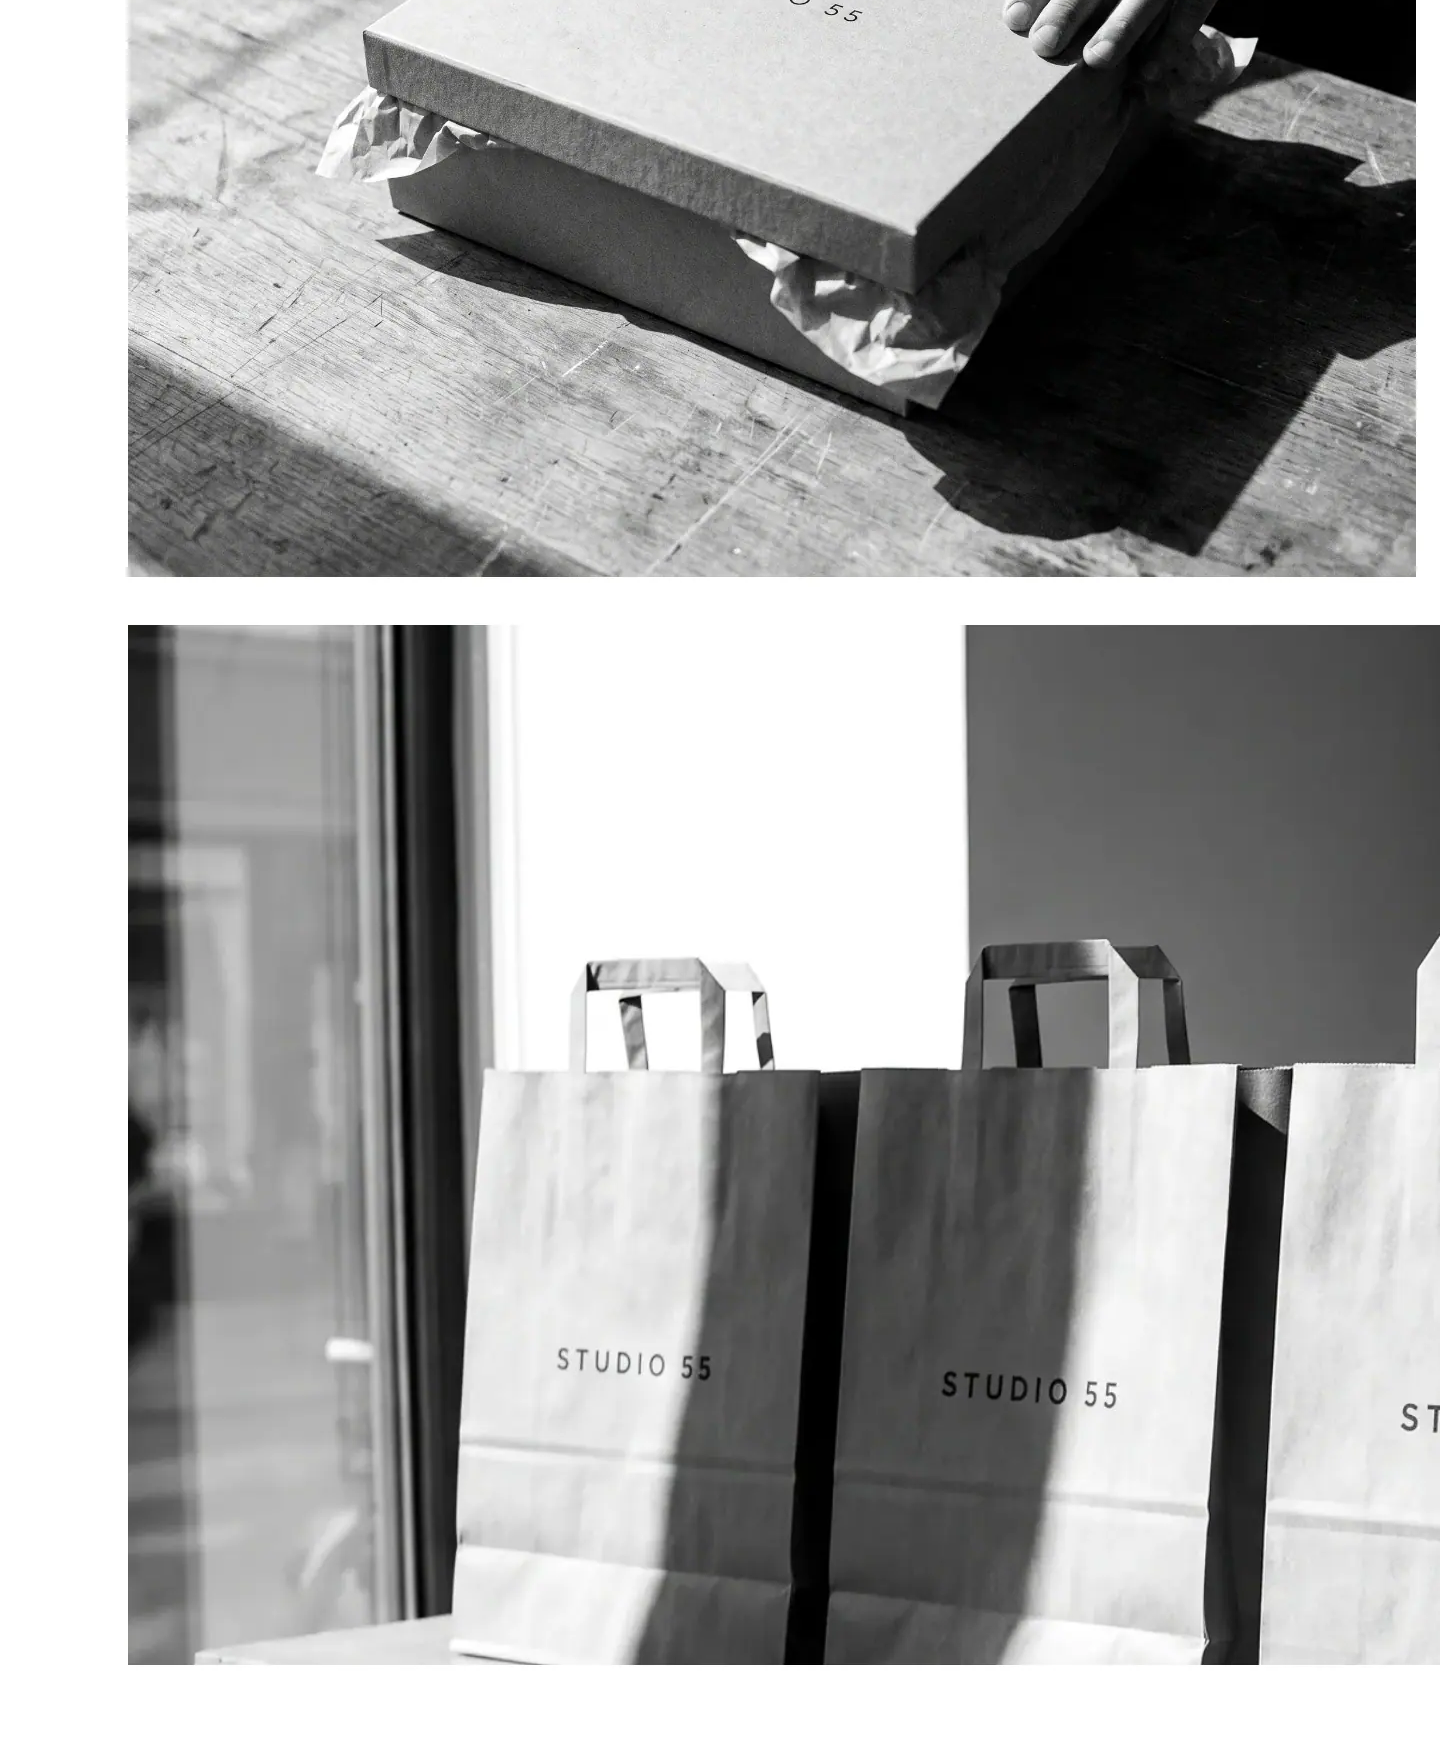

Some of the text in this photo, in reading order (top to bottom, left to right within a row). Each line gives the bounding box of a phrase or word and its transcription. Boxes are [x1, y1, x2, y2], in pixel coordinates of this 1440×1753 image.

[823, 2, 863, 23] 55
[556, 1347, 712, 1382] STUDIO 55
[941, 1371, 1119, 1411] STUDIO 55
